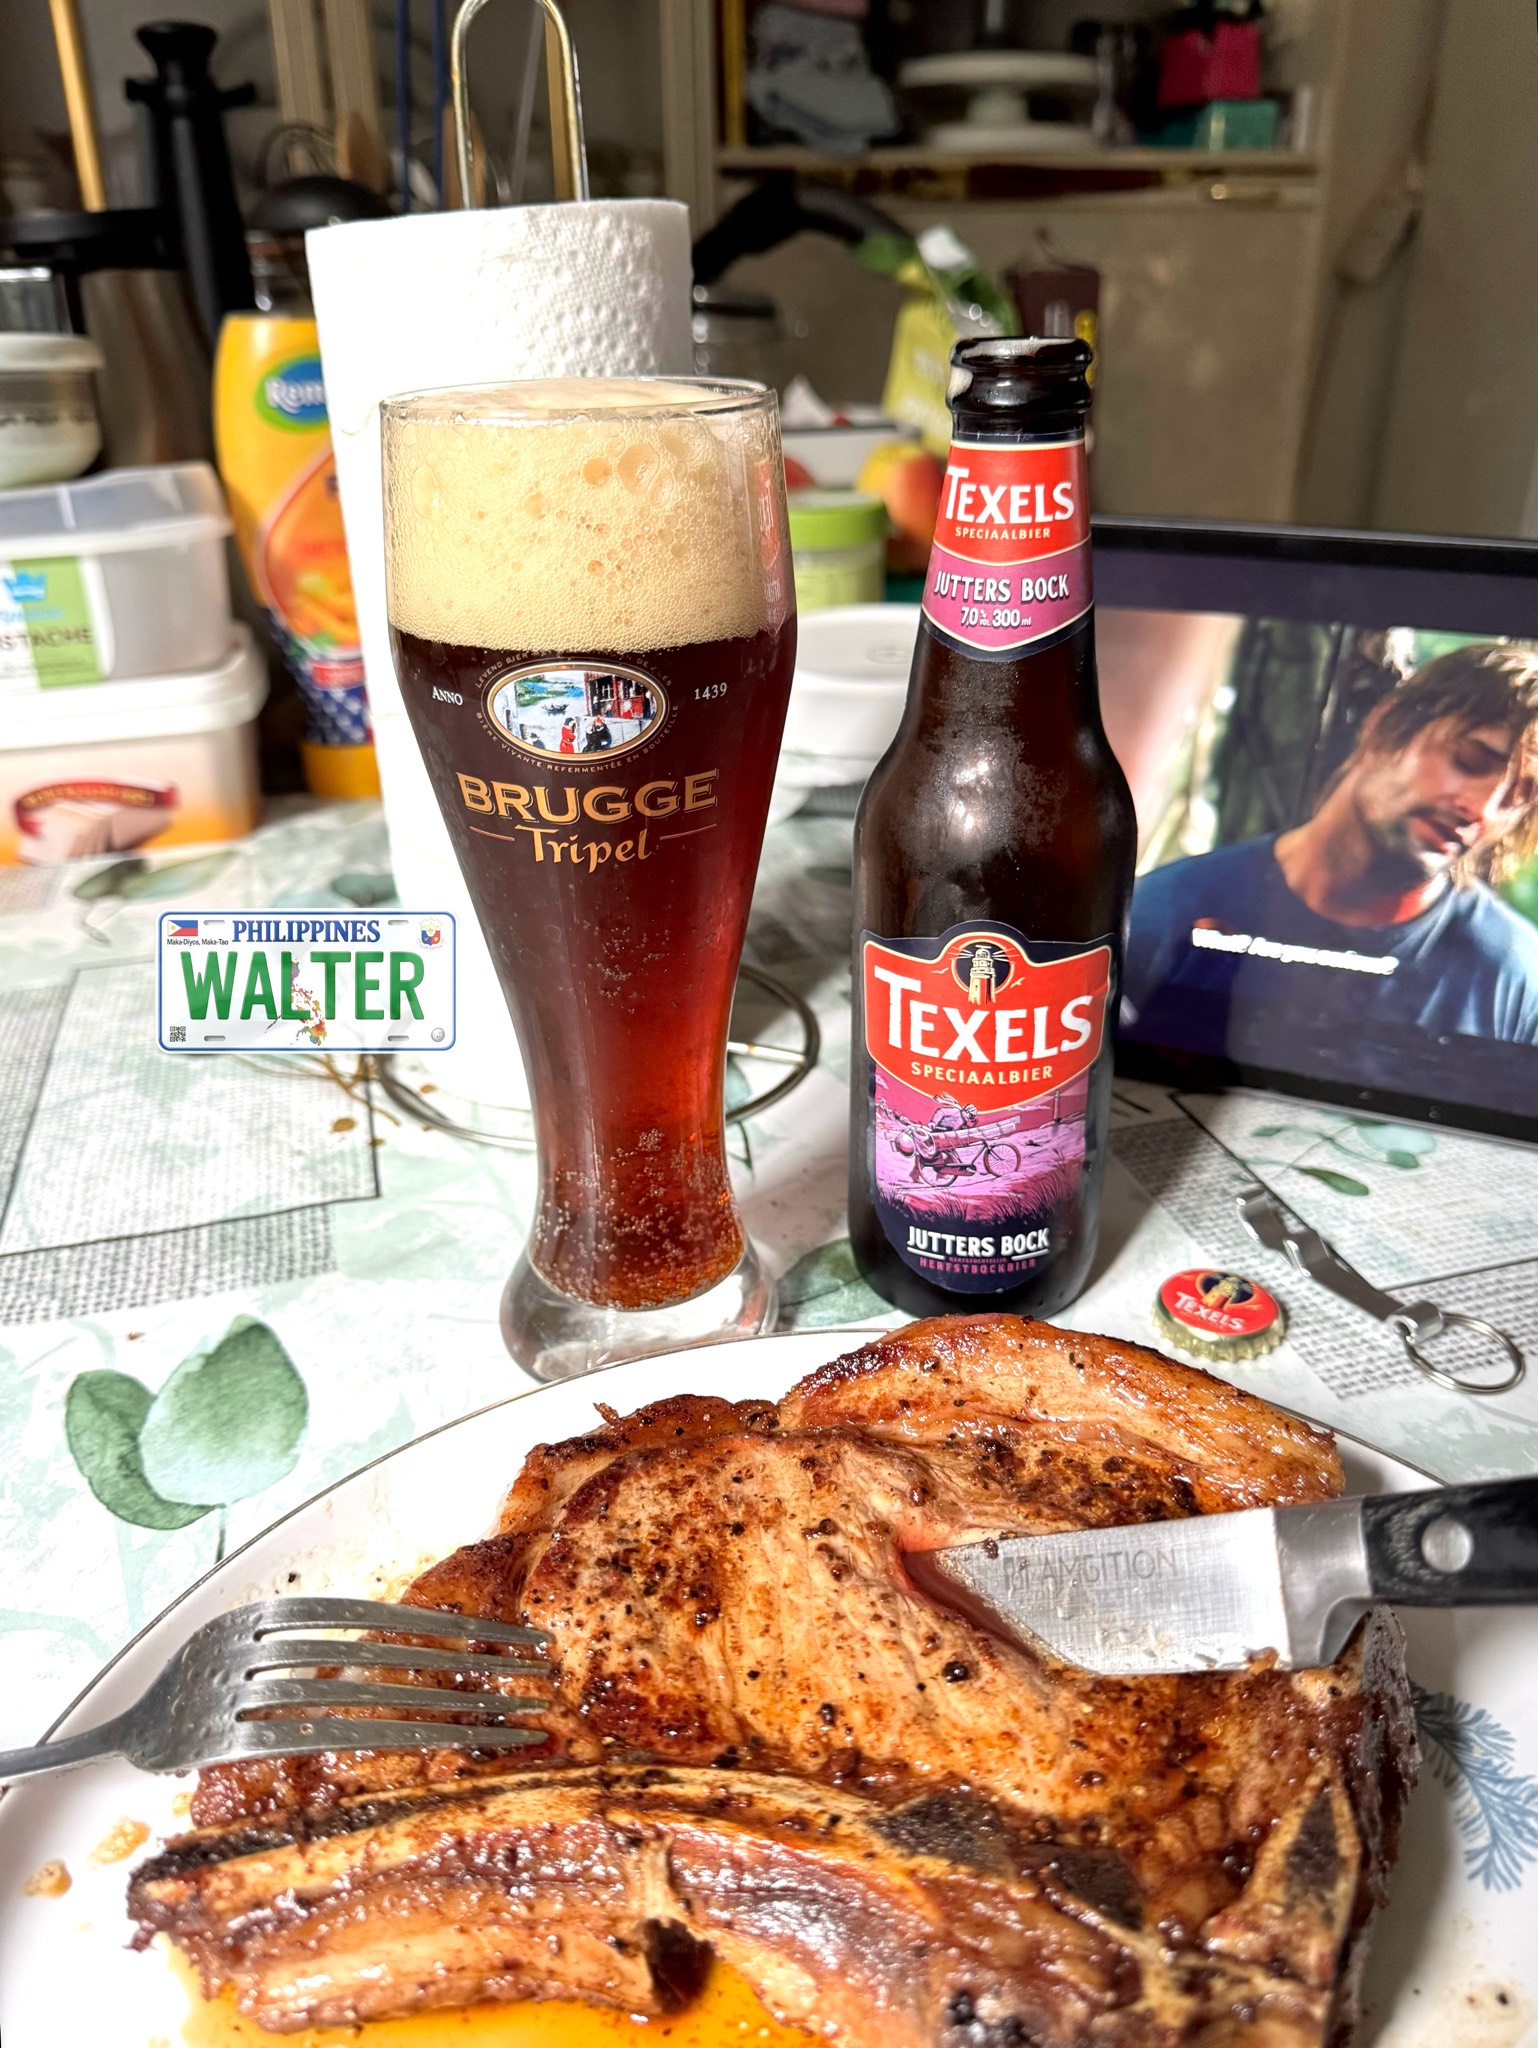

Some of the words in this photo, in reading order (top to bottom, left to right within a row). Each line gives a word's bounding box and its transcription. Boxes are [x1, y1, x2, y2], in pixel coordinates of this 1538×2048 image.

[264, 377, 326, 414] Rem
[945, 466, 1075, 524] TEXELS
[955, 526, 1050, 540] SPECIAALBIER
[934, 571, 1011, 603] JUTTERS
[1021, 574, 1070, 603] BOCK
[992, 608, 1020, 627] 300
[475, 661, 504, 689] LEVEND
[505, 652, 529, 664] BIER
[432, 685, 464, 706] ANNO
[694, 682, 728, 700] 1439
[501, 743, 543, 768] VIVANTE
[627, 753, 640, 763] EN
[642, 704, 680, 754] BOUTEILLE
[456, 768, 720, 825] BRUGGE
[514, 824, 654, 874] Tripel
[874, 965, 1093, 1063] TEXELS
[911, 1062, 1053, 1085] SPECIAALBIER
[907, 1226, 996, 1257] JUTTERS
[1000, 1227, 1050, 1257] BOCK
[919, 1257, 1036, 1275] HERFSTBOCKBIER
[1174, 1290, 1245, 1332] TEXELS
